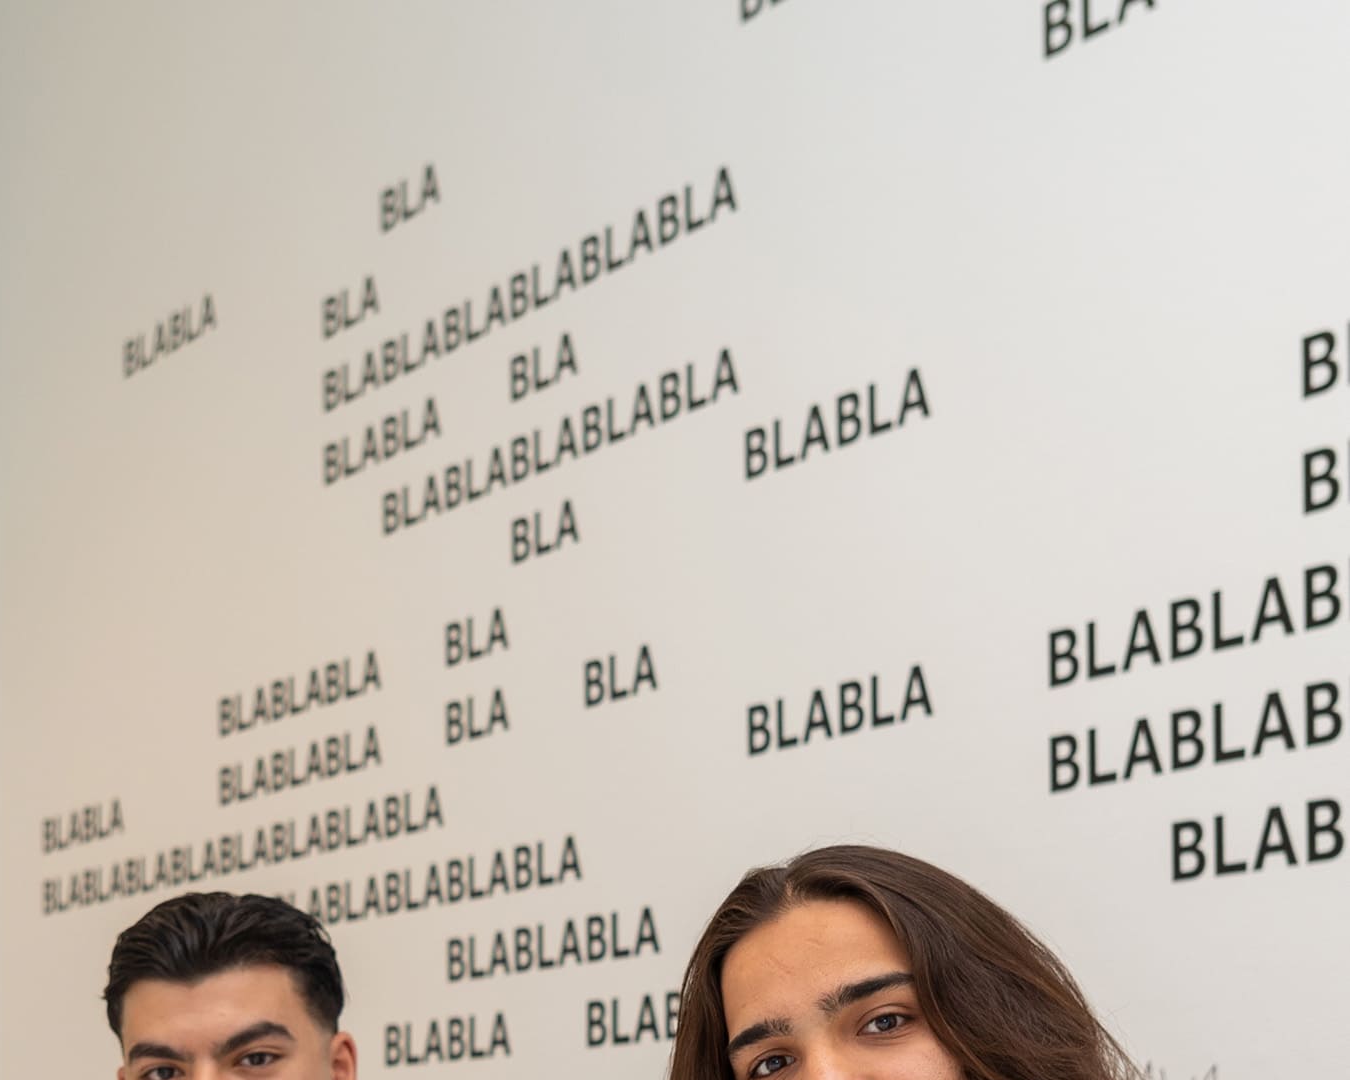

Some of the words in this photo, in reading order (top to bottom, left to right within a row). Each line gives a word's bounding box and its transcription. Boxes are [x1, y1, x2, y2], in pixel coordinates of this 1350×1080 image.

[379, 164, 441, 234] BLA
[321, 276, 380, 340] BLA
[323, 166, 738, 413] BLABLABLABLABLABLA
[122, 294, 217, 379] BLABLA
[509, 332, 579, 403] BLA
[323, 397, 442, 487] BLABLA
[382, 347, 740, 536] BLABLABLABLABLA
[744, 367, 931, 481] BLABLA
[511, 499, 580, 565] BLA
[445, 607, 510, 668] BLA
[1048, 564, 1342, 689] BLABLAB
[218, 650, 382, 738] BLABLABLA
[583, 644, 658, 709] BLA
[747, 664, 933, 757] BLABLA
[445, 688, 510, 747] BLA
[218, 725, 382, 807] BLABLABLA
[41, 799, 125, 855] BLABLA
[447, 906, 661, 983] BLABLABLA
[384, 1012, 512, 1068] BLABLA
